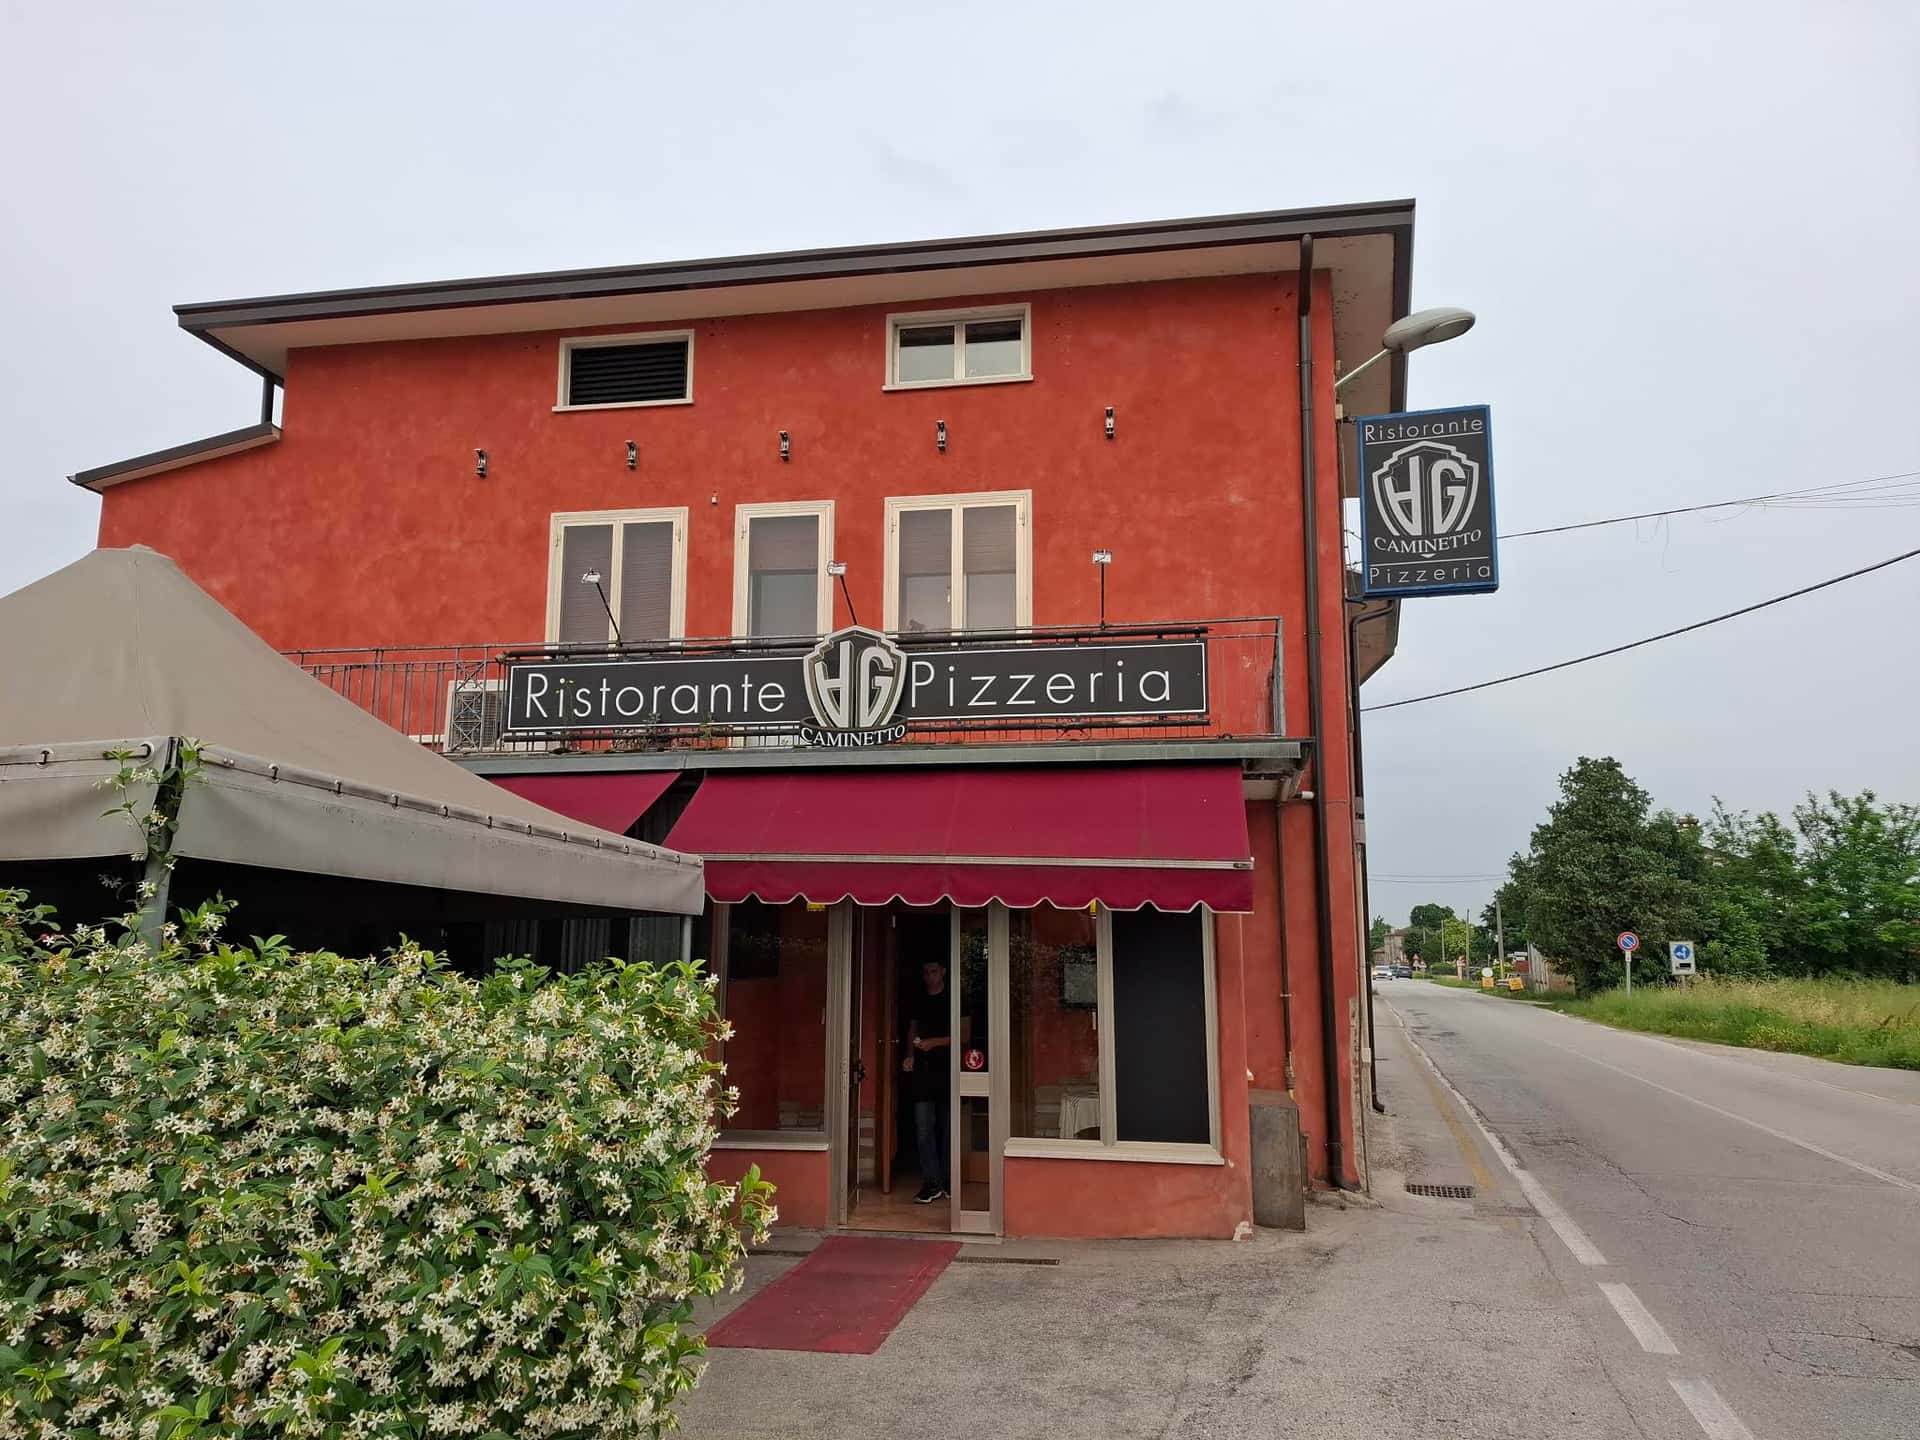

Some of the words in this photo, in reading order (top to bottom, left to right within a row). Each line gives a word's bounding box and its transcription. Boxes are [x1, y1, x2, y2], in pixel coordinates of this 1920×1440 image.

[1365, 417, 1484, 441] Ristorante
[1384, 455, 1467, 536] HG
[1374, 529, 1482, 554] CAMINETTO
[1369, 562, 1491, 585] Pizzeria
[526, 673, 786, 718] Ristorante
[911, 660, 1170, 708] Pizzeria
[815, 640, 894, 728] HG
[801, 724, 905, 747] CAMINETTO
